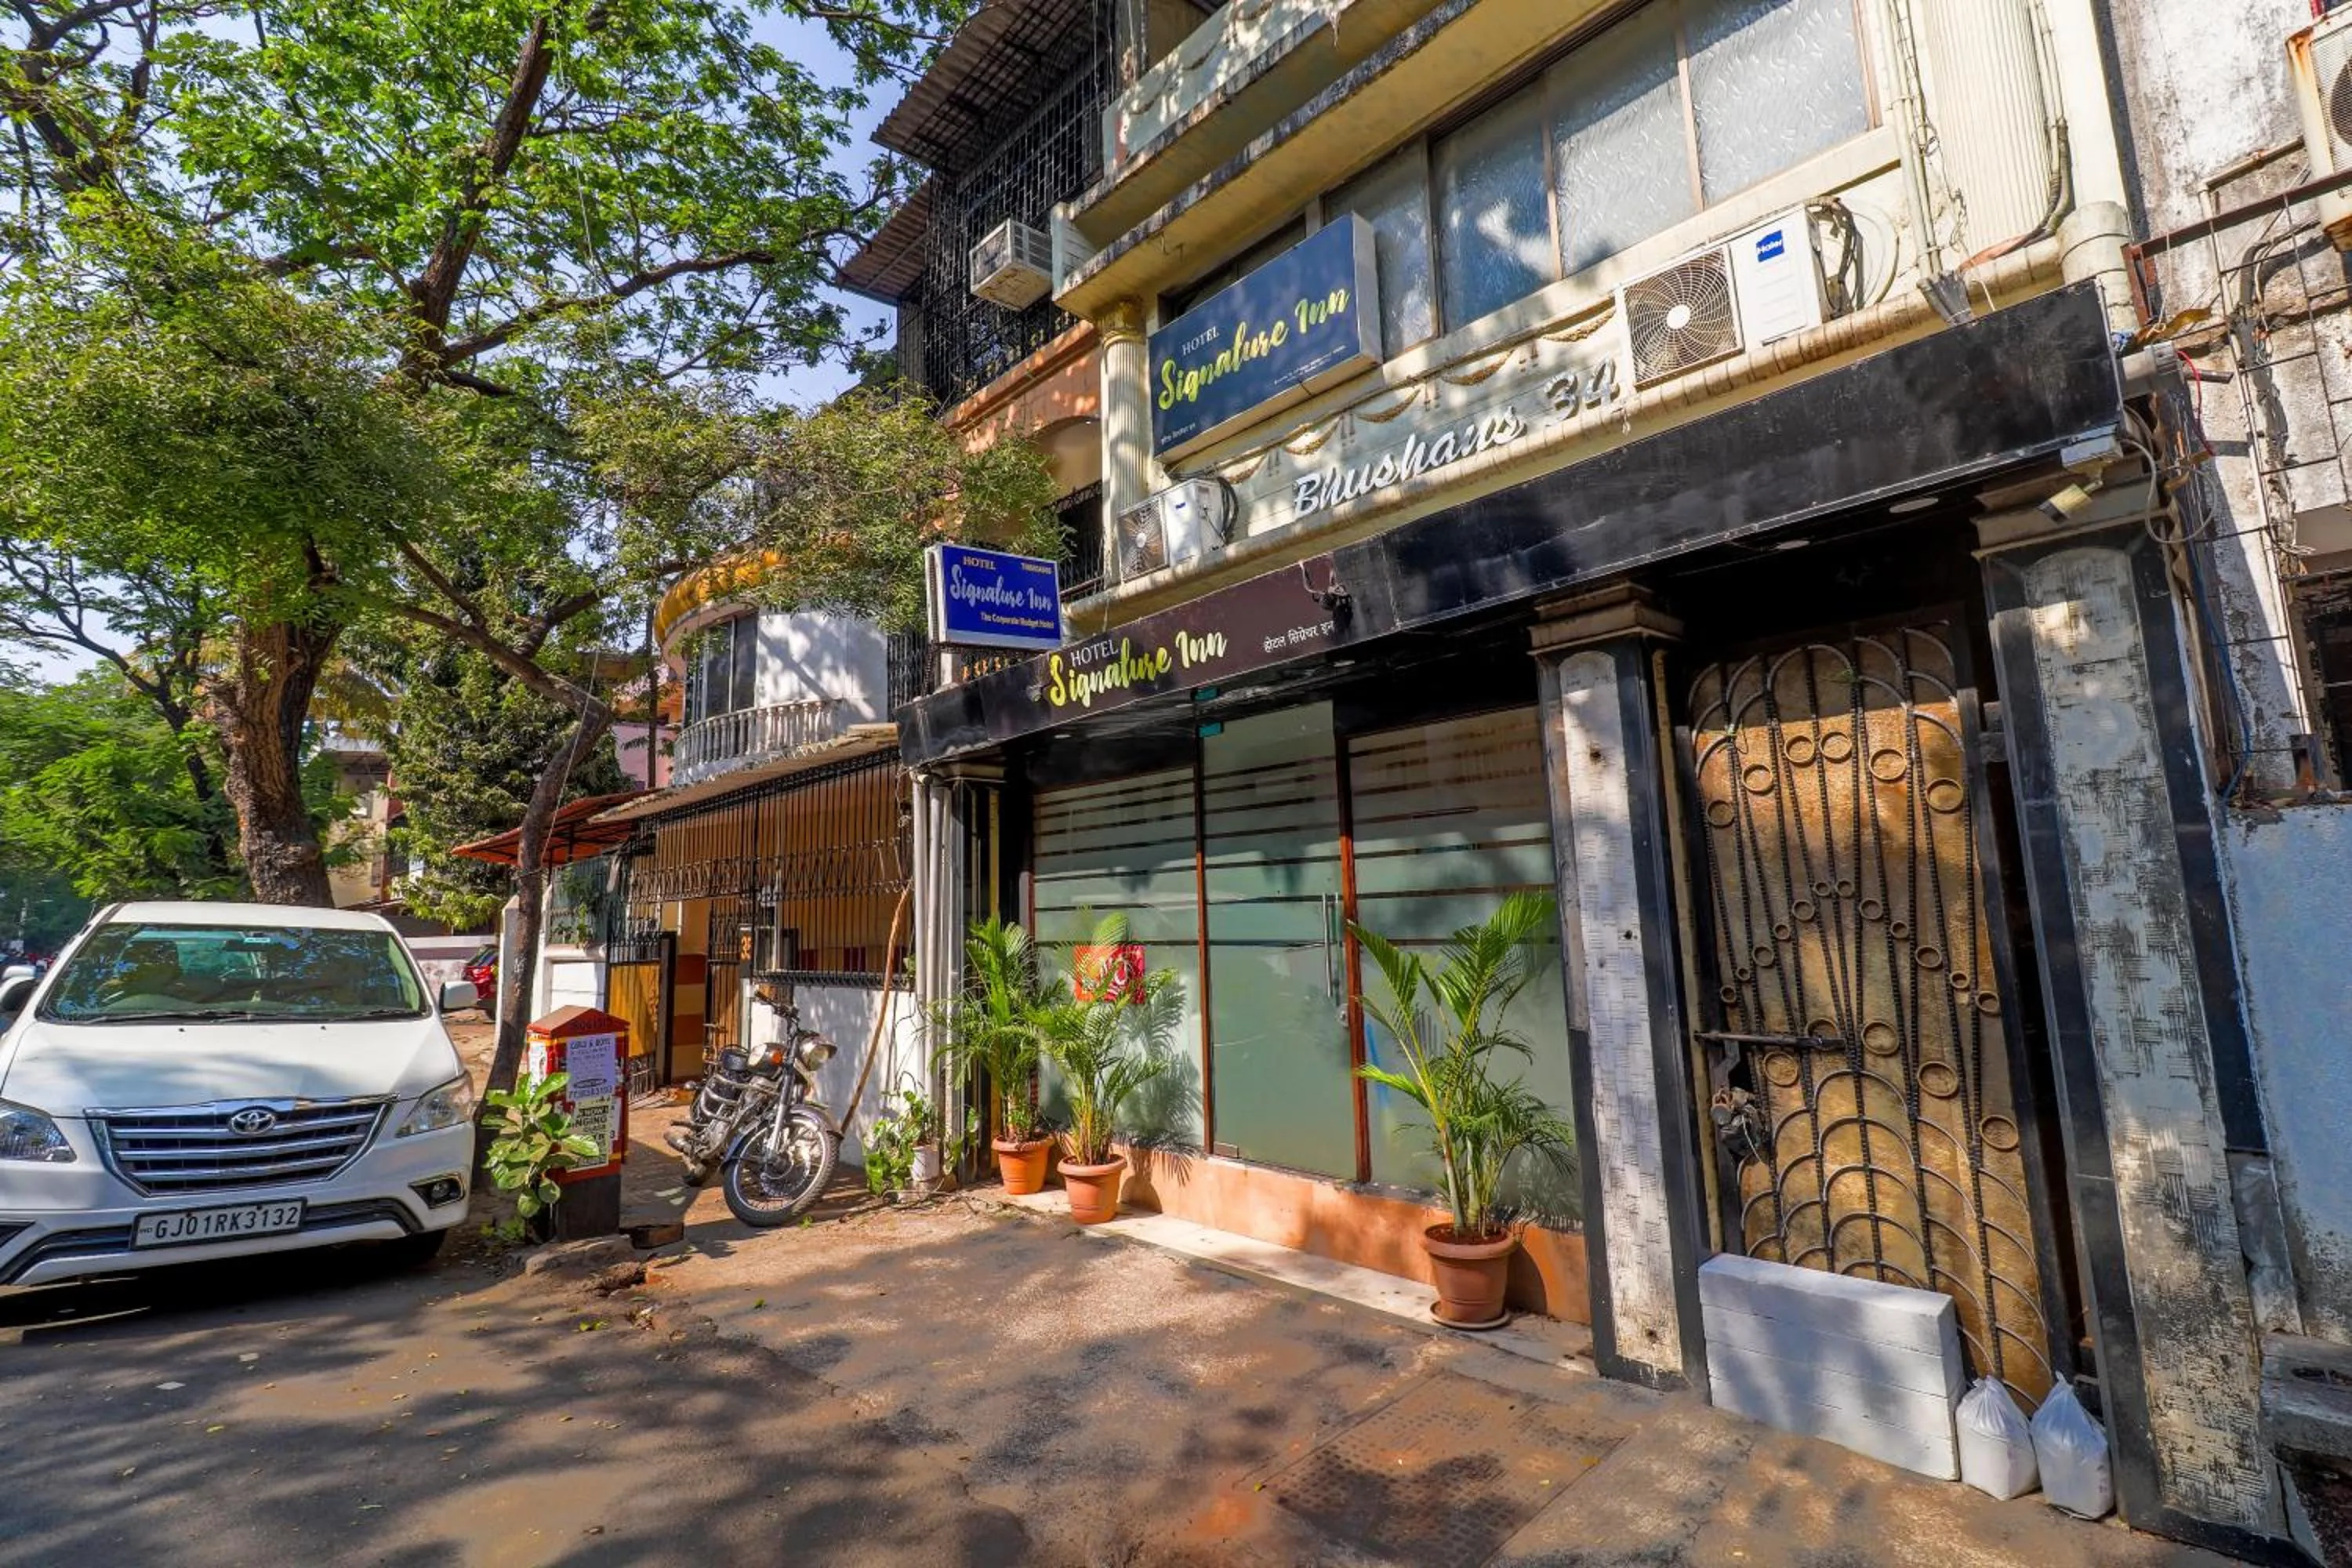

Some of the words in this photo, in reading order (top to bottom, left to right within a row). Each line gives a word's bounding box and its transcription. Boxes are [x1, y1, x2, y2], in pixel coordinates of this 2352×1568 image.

[1158, 320, 1289, 411] Signature
[1295, 288, 1349, 334] Inn
[1182, 326, 1219, 355] HOTEL
[963, 556, 996, 571] HOTEL
[950, 564, 1025, 608] Signature
[1027, 587, 1052, 612] Inn
[1070, 639, 1119, 666] HOTEL
[1050, 637, 1172, 708] Signature
[1175, 630, 1227, 668] Inn
[155, 1207, 299, 1239] GJ01RK3132
